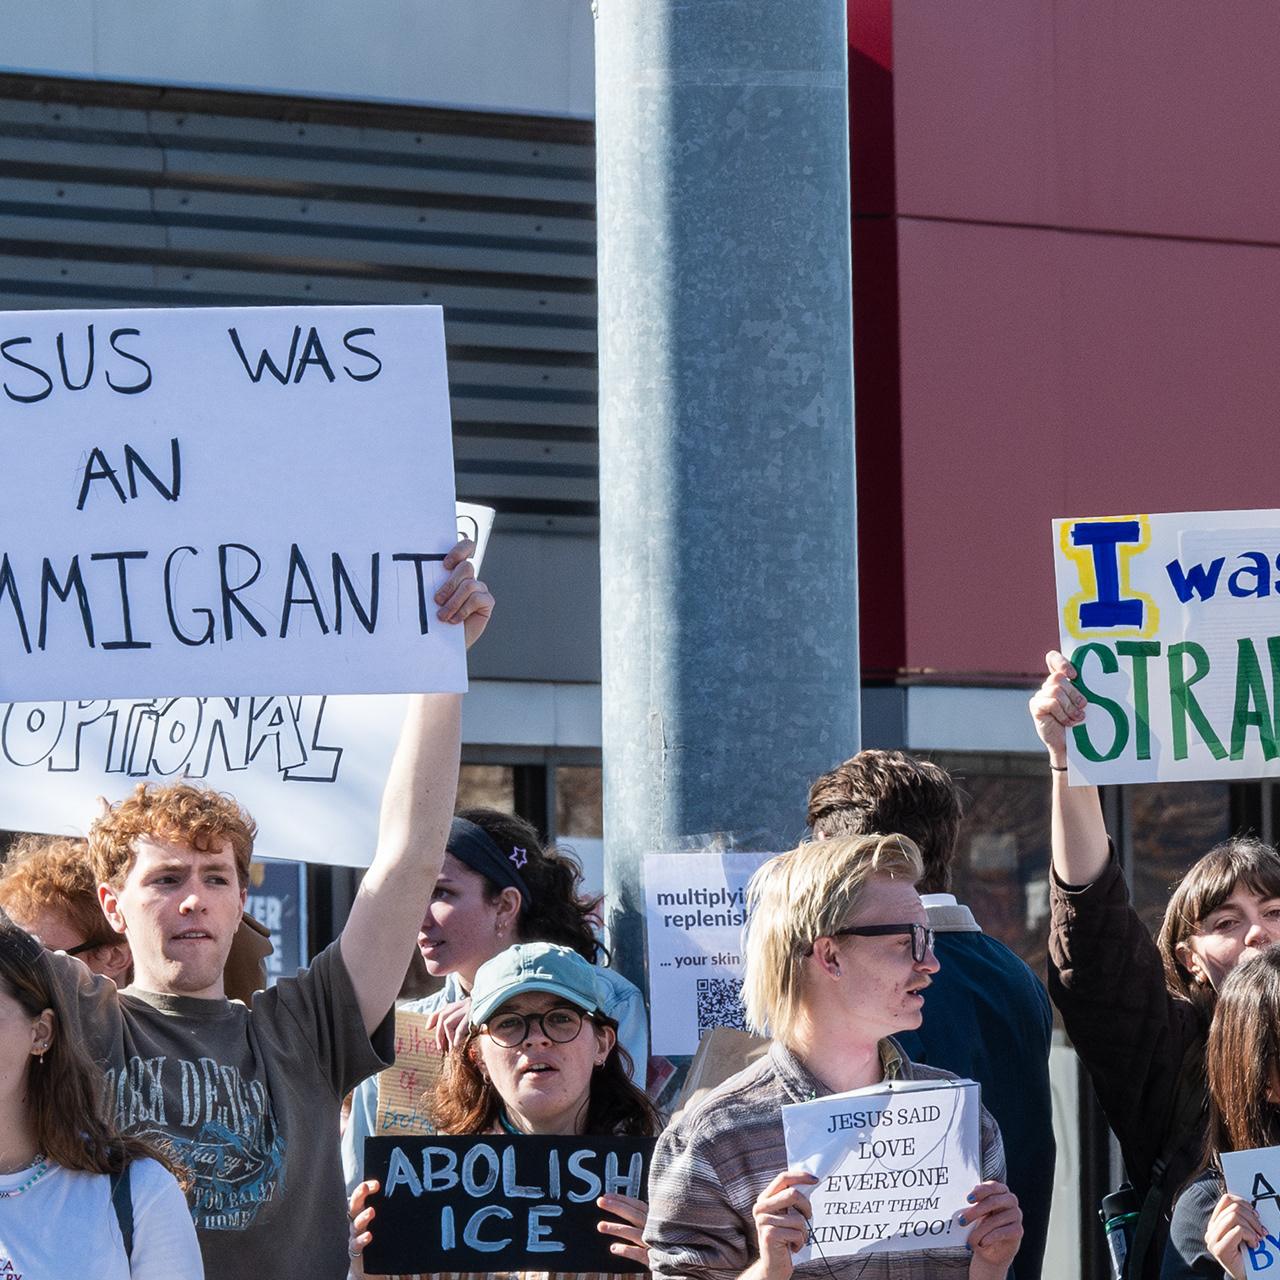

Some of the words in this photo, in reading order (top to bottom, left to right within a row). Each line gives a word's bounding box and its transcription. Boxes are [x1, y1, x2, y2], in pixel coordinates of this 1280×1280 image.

[0, 325, 152, 403] SUS
[228, 325, 382, 384] WAS
[76, 438, 181, 510] AN
[1071, 521, 1143, 630] I
[2, 697, 343, 782] OPTIONAL
[674, 956, 707, 967] your
[711, 952, 740, 966] skin
[400, 1069, 417, 1101] of
[828, 1111, 893, 1133] JESUS
[897, 1105, 941, 1126] SAID
[859, 1138, 915, 1161] LOVE
[384, 1144, 642, 1203] ABOLISH
[825, 1166, 949, 1193] EVERYONE
[824, 1200, 884, 1215] TREAT
[887, 1197, 940, 1213] THEM
[441, 1205, 566, 1253] ICE
[806, 1223, 891, 1246] KINDLY,
[900, 1219, 953, 1238] TOO!
